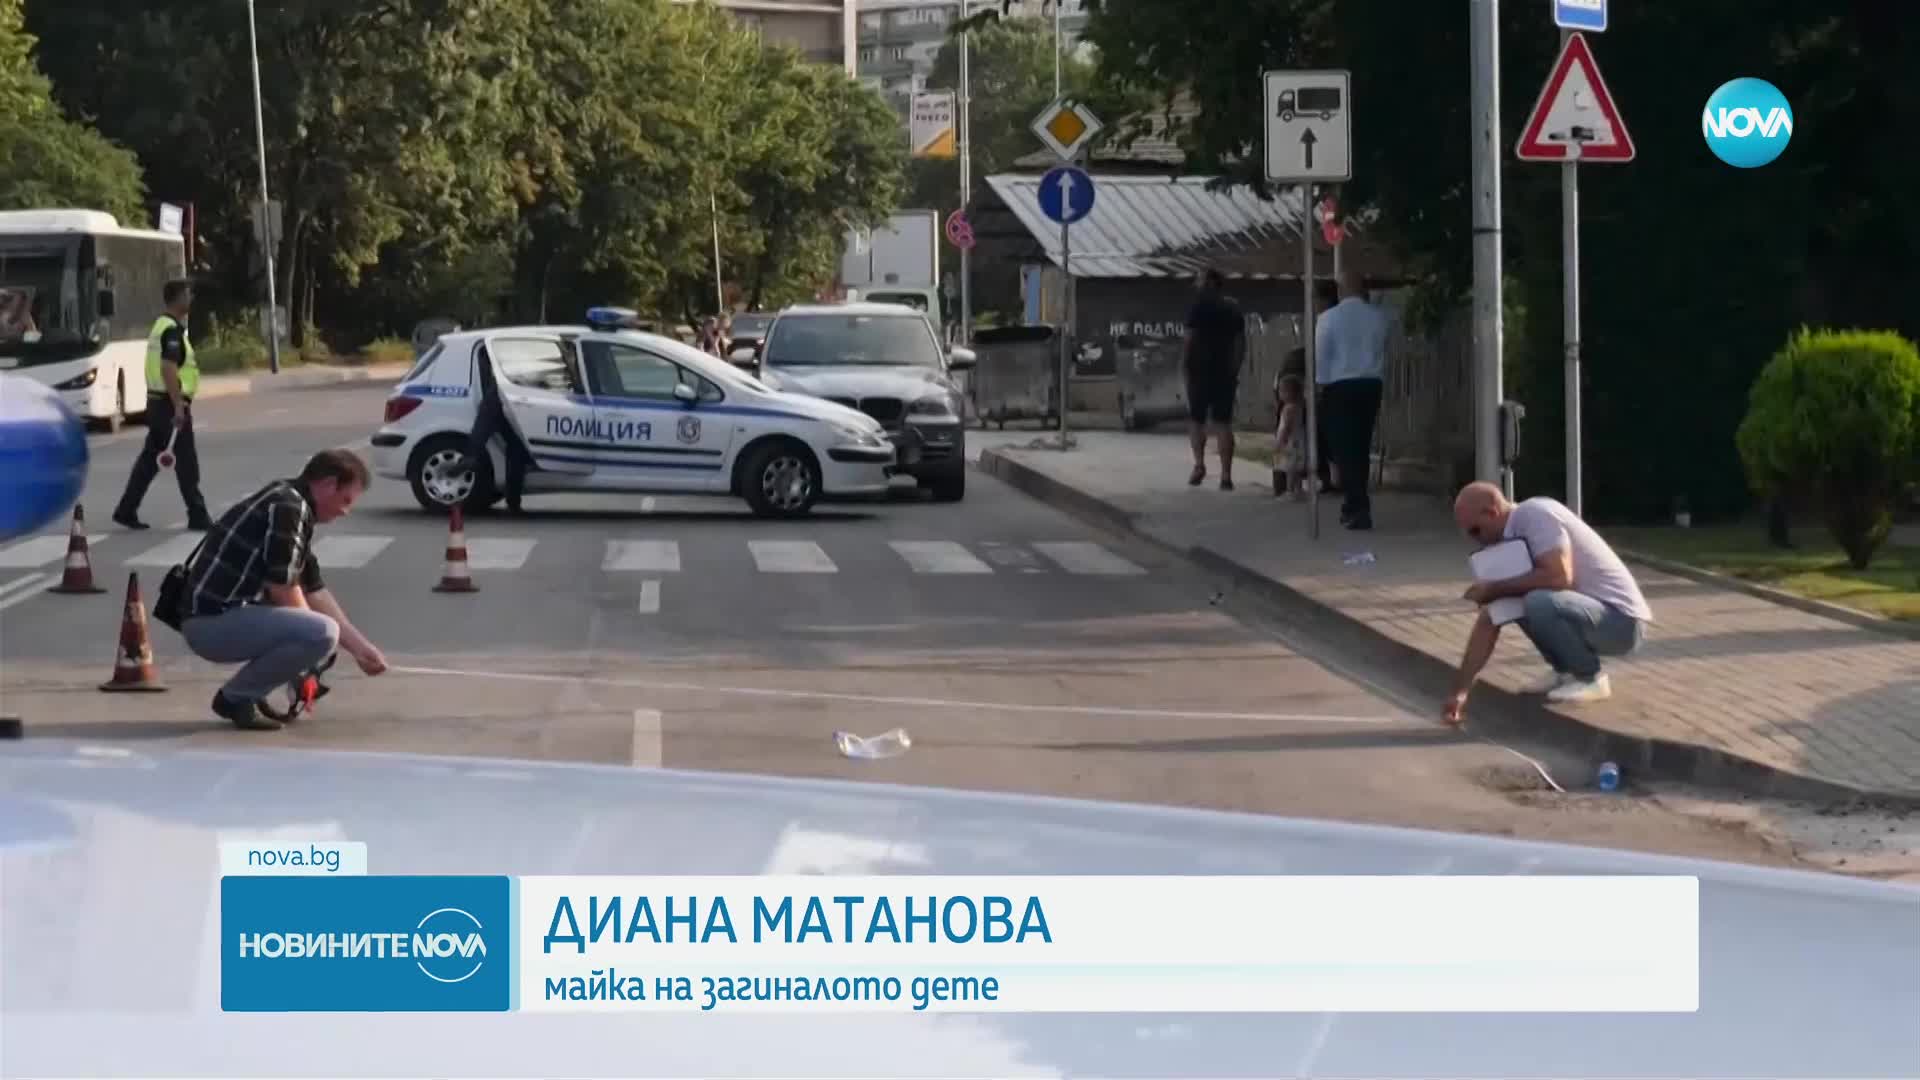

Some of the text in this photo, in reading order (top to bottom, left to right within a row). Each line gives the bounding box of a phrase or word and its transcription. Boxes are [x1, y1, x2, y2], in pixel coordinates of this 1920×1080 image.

[1109, 320, 1185, 338] НЕ ПОДПИ
[547, 414, 652, 442] ПОЛИЦИЯ
